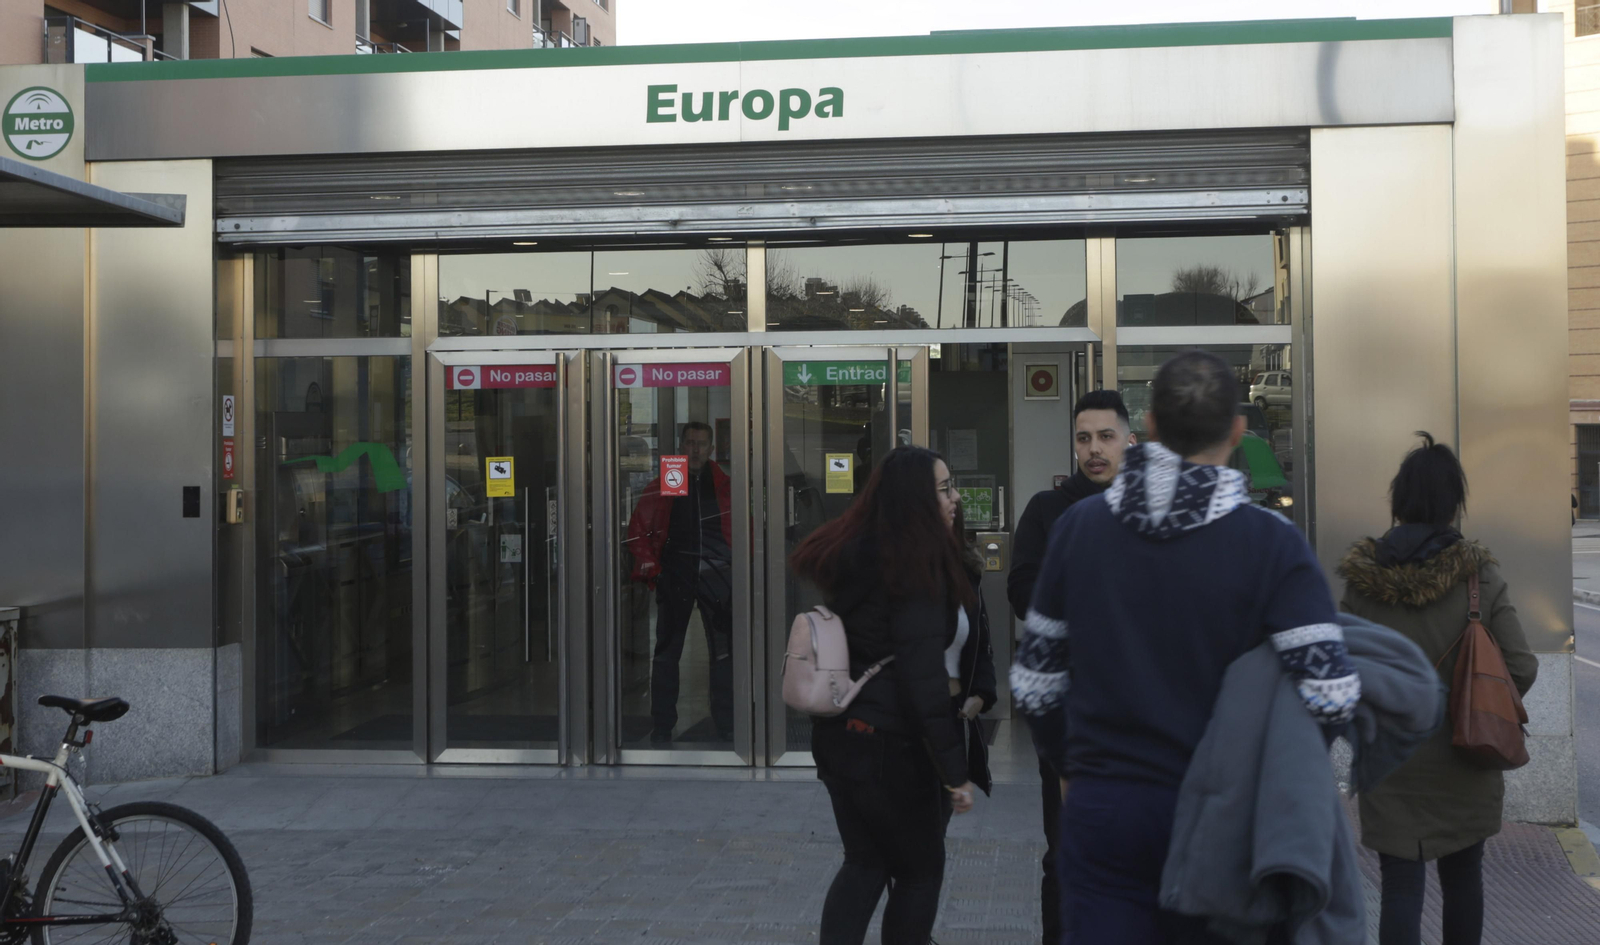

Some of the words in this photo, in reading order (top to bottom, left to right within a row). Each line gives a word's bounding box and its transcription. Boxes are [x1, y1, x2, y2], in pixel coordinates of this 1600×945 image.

[646, 84, 844, 131] Europa
[15, 117, 63, 130] Metro
[490, 369, 511, 382] No
[652, 368, 673, 381] No
[677, 369, 722, 383] pasar
[826, 366, 886, 380] Entrad
